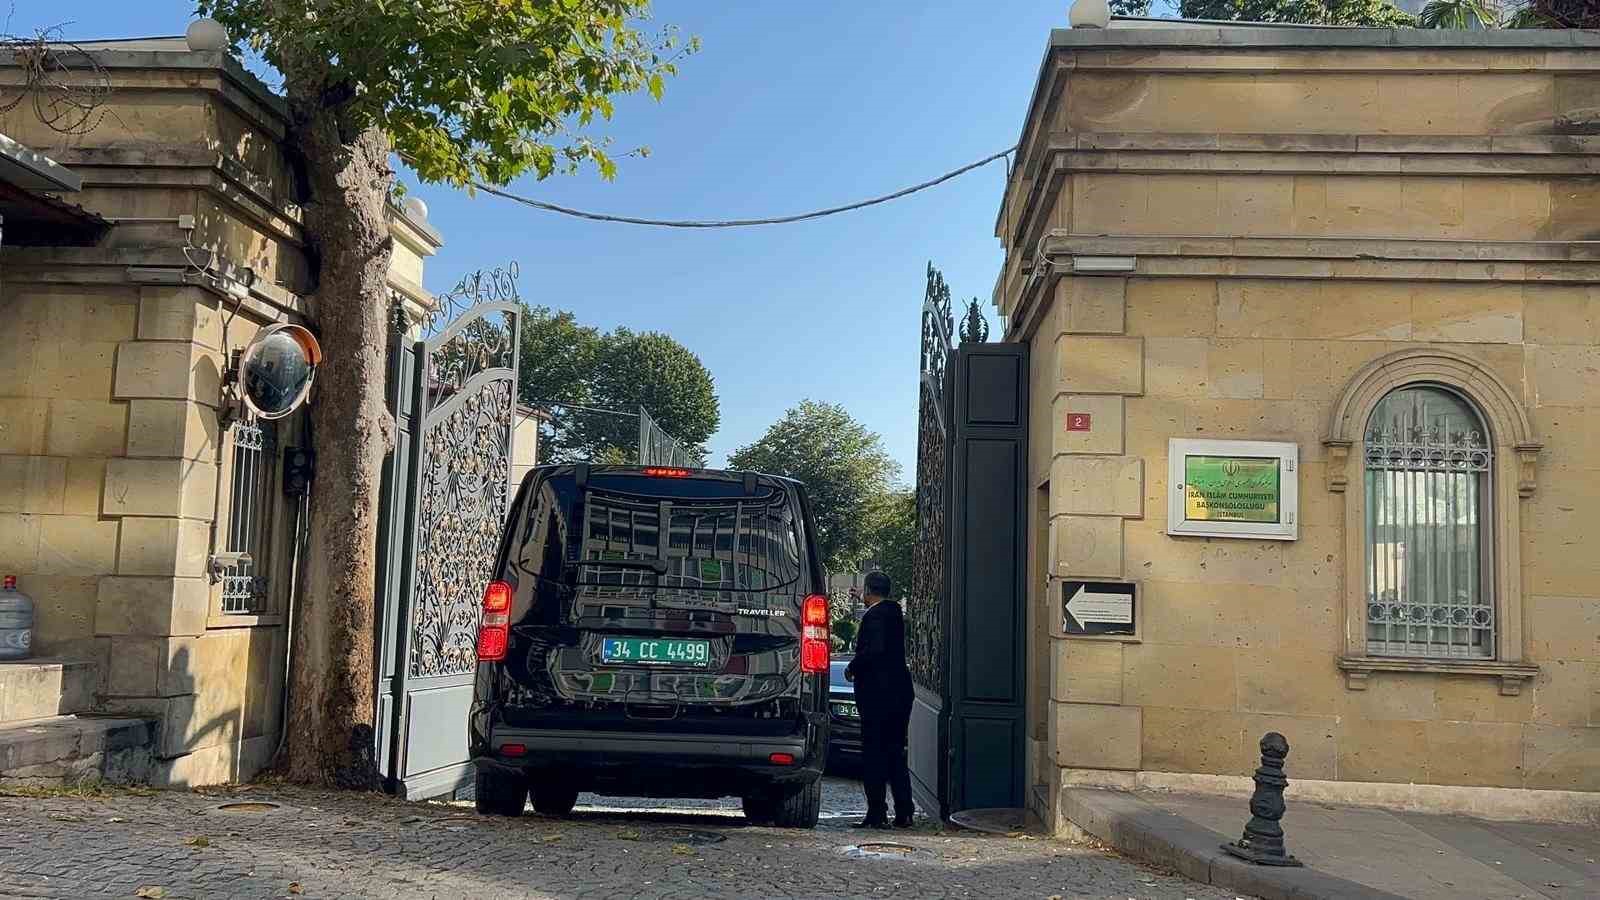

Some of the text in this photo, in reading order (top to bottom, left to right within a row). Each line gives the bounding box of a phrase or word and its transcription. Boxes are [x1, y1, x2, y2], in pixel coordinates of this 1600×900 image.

[1075, 416, 1082, 427] 2
[738, 608, 786, 617] TRAVELLER
[612, 641, 705, 660] 34 CC 4499
